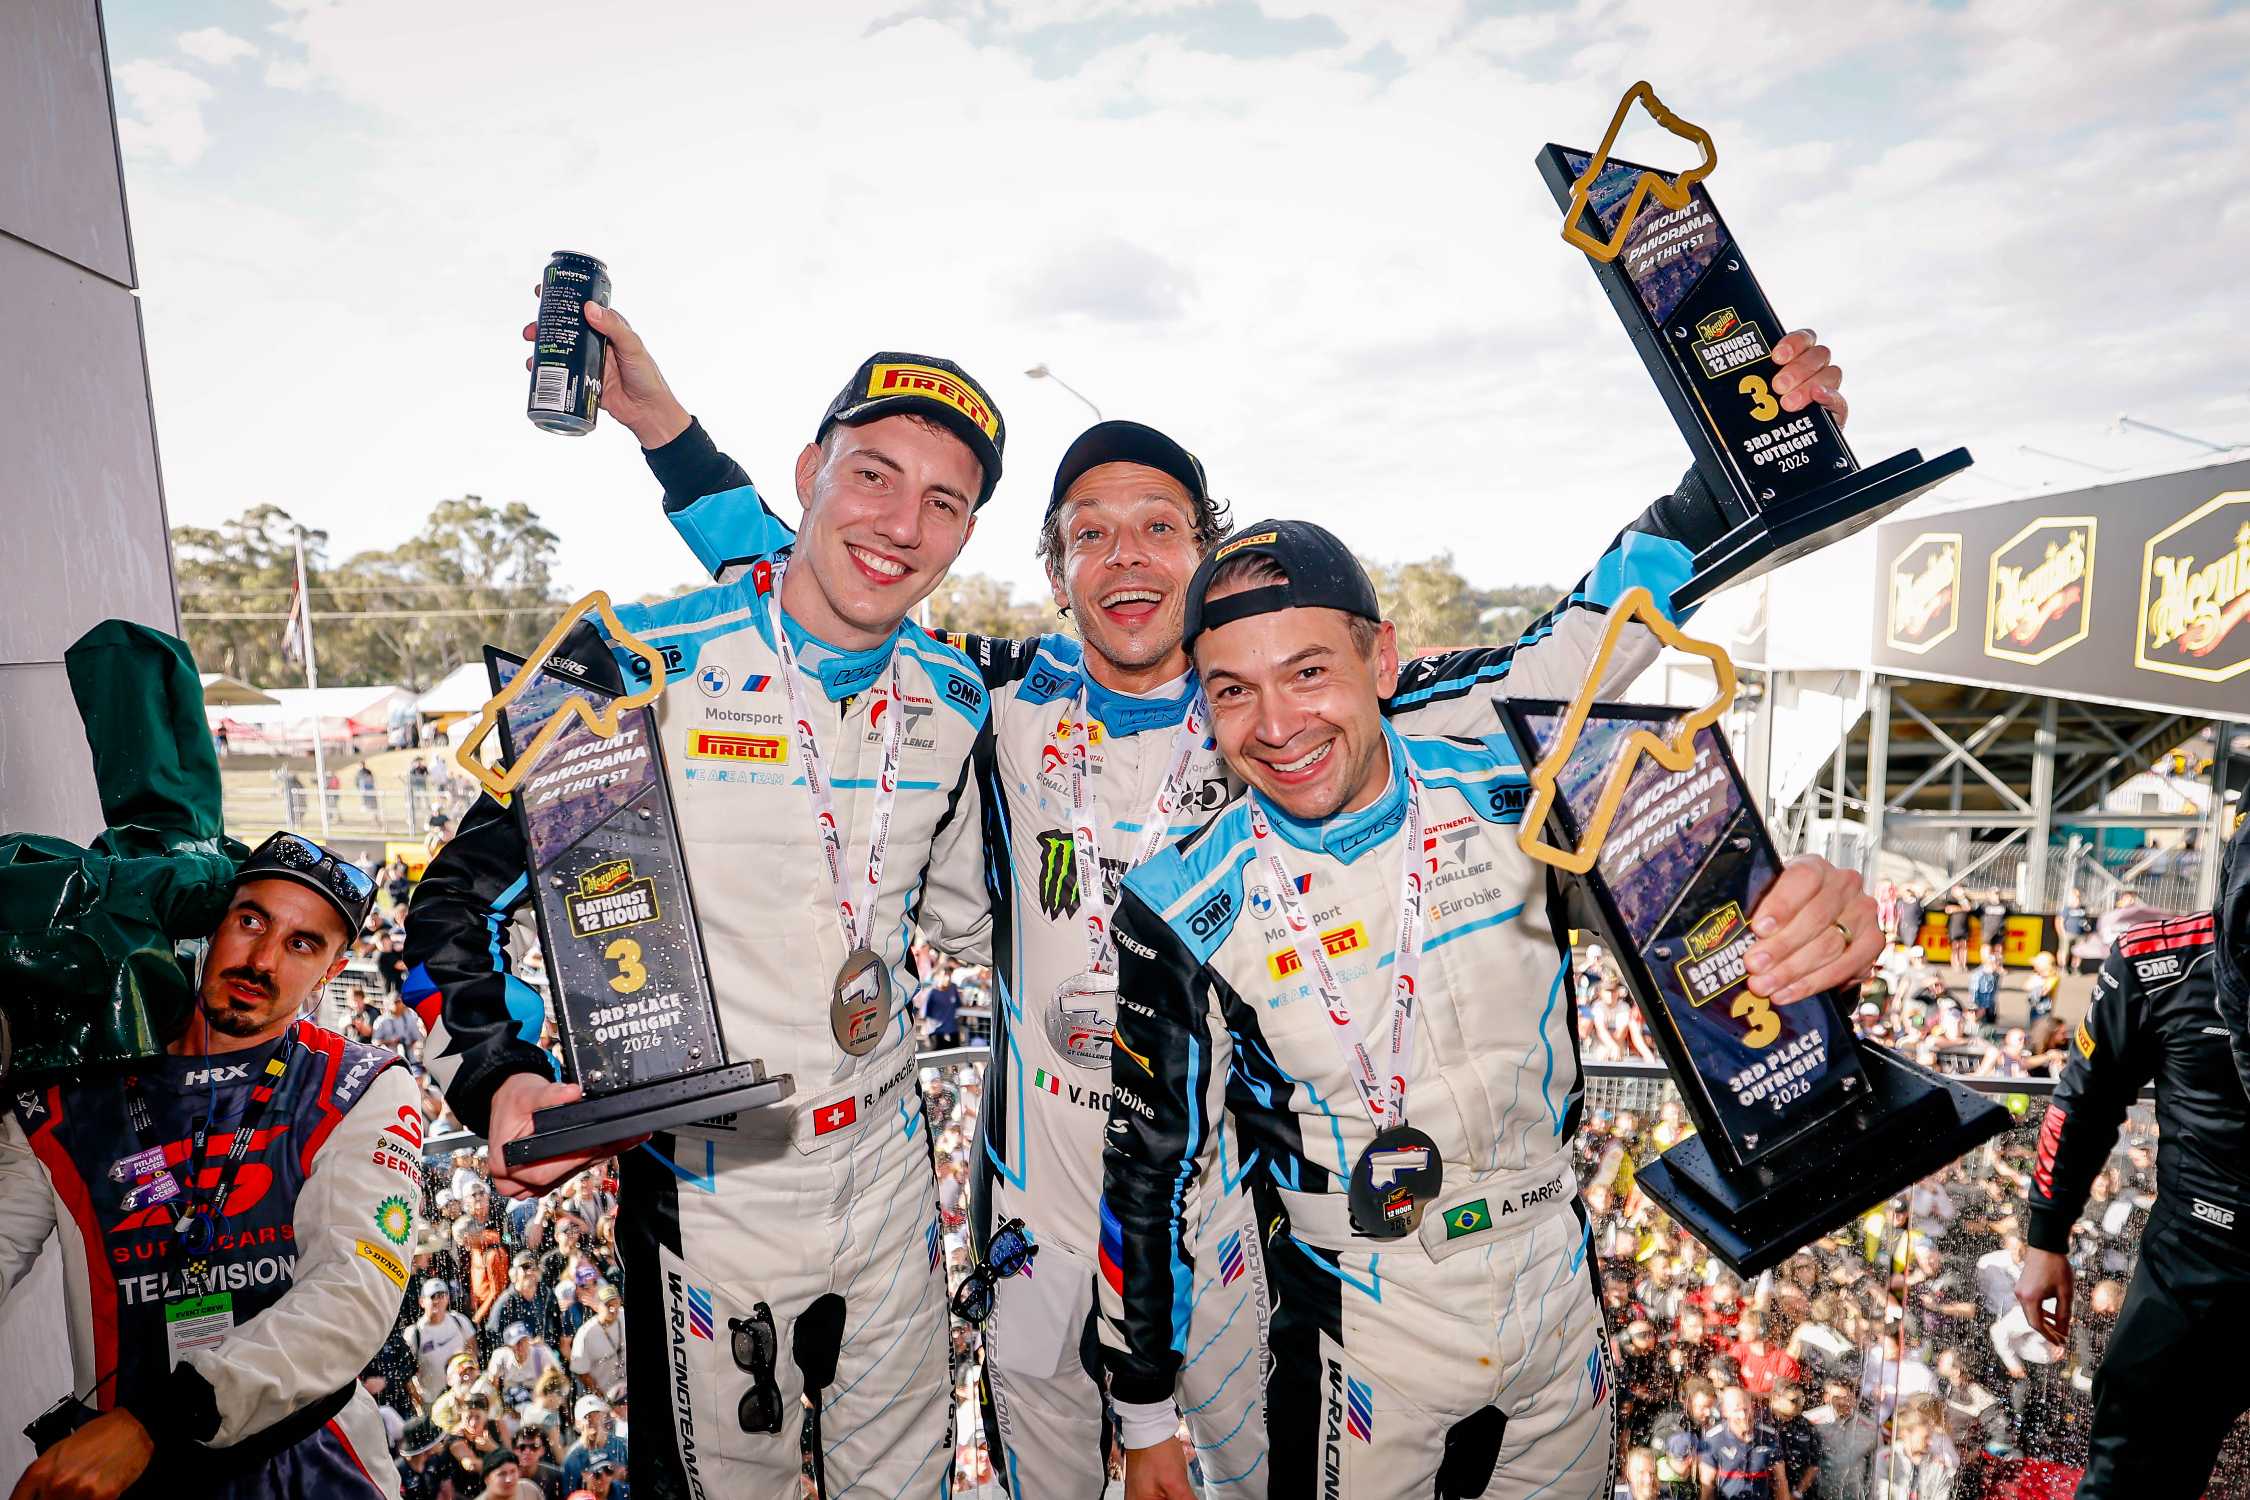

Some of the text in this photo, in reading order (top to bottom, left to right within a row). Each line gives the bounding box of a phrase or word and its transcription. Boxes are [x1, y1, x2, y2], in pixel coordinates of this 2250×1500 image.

[1647, 200, 1700, 235] MOUNT
[1628, 213, 1714, 262] PANORAMA
[1639, 234, 1704, 273] BATHURST
[1700, 310, 1735, 338] Meguiar's
[1701, 331, 1758, 361] BATHURST
[1709, 341, 1765, 373] 12 HOUR
[883, 370, 990, 430] PIRELLI
[1739, 375, 1779, 421] 3
[1744, 417, 1814, 453] 3RD PLACE
[1753, 430, 1819, 466] OUTRIGHT
[1777, 453, 1810, 473] 2026
[2149, 520, 2250, 650] Megui
[948, 679, 982, 705] OMP
[706, 707, 783, 725] Motorsport
[561, 729, 639, 764] MOUNT
[698, 735, 779, 758] PIRELLI
[527, 746, 646, 792] PANORAMA
[536, 768, 630, 805] BATHURST
[1604, 766, 1726, 862] PANORAMA
[1617, 798, 1711, 873] BATHURST
[583, 863, 630, 894] Meguiar's
[1436, 861, 1493, 887] CHALLENGE
[575, 889, 648, 917] BATHURST
[578, 902, 652, 932] 12 HOUR
[1192, 894, 1231, 936] OMP
[1440, 887, 1502, 916] Eurobike
[1694, 905, 1737, 954] Meguiar's
[604, 938, 648, 993] 3
[1696, 960, 1748, 997] 12 HO
[2136, 959, 2179, 978] OMP
[589, 993, 684, 1026] 3RD PLACE
[1731, 990, 1781, 1049] 3
[594, 1010, 682, 1043] OUTRIGHT
[623, 1035, 663, 1054] 2026
[185, 1063, 250, 1086] HRX
[1728, 1029, 1823, 1093] 3RD PLACE
[336, 1052, 383, 1102] HRX
[1738, 1047, 1826, 1107] OUTRIGHT
[864, 1093, 876, 1109] R.
[1768, 1078, 1811, 1110] 2026
[115, 1166, 125, 1178] 1
[134, 1154, 164, 1168] PITLANE
[135, 1161, 165, 1176] ACCESS
[147, 1186, 177, 1204] ACCESS
[154, 1179, 174, 1193] GRID
[127, 1196, 138, 1209] 2
[1387, 1210, 1395, 1218] 12
[1395, 1205, 1413, 1215] HOUR
[1502, 1199, 1518, 1216] A.
[2194, 1202, 2234, 1226] OMP
[118, 1255, 295, 1305] TELEVISION
[371, 1251, 405, 1280] DUNLOP
[200, 1304, 223, 1314] CREW
